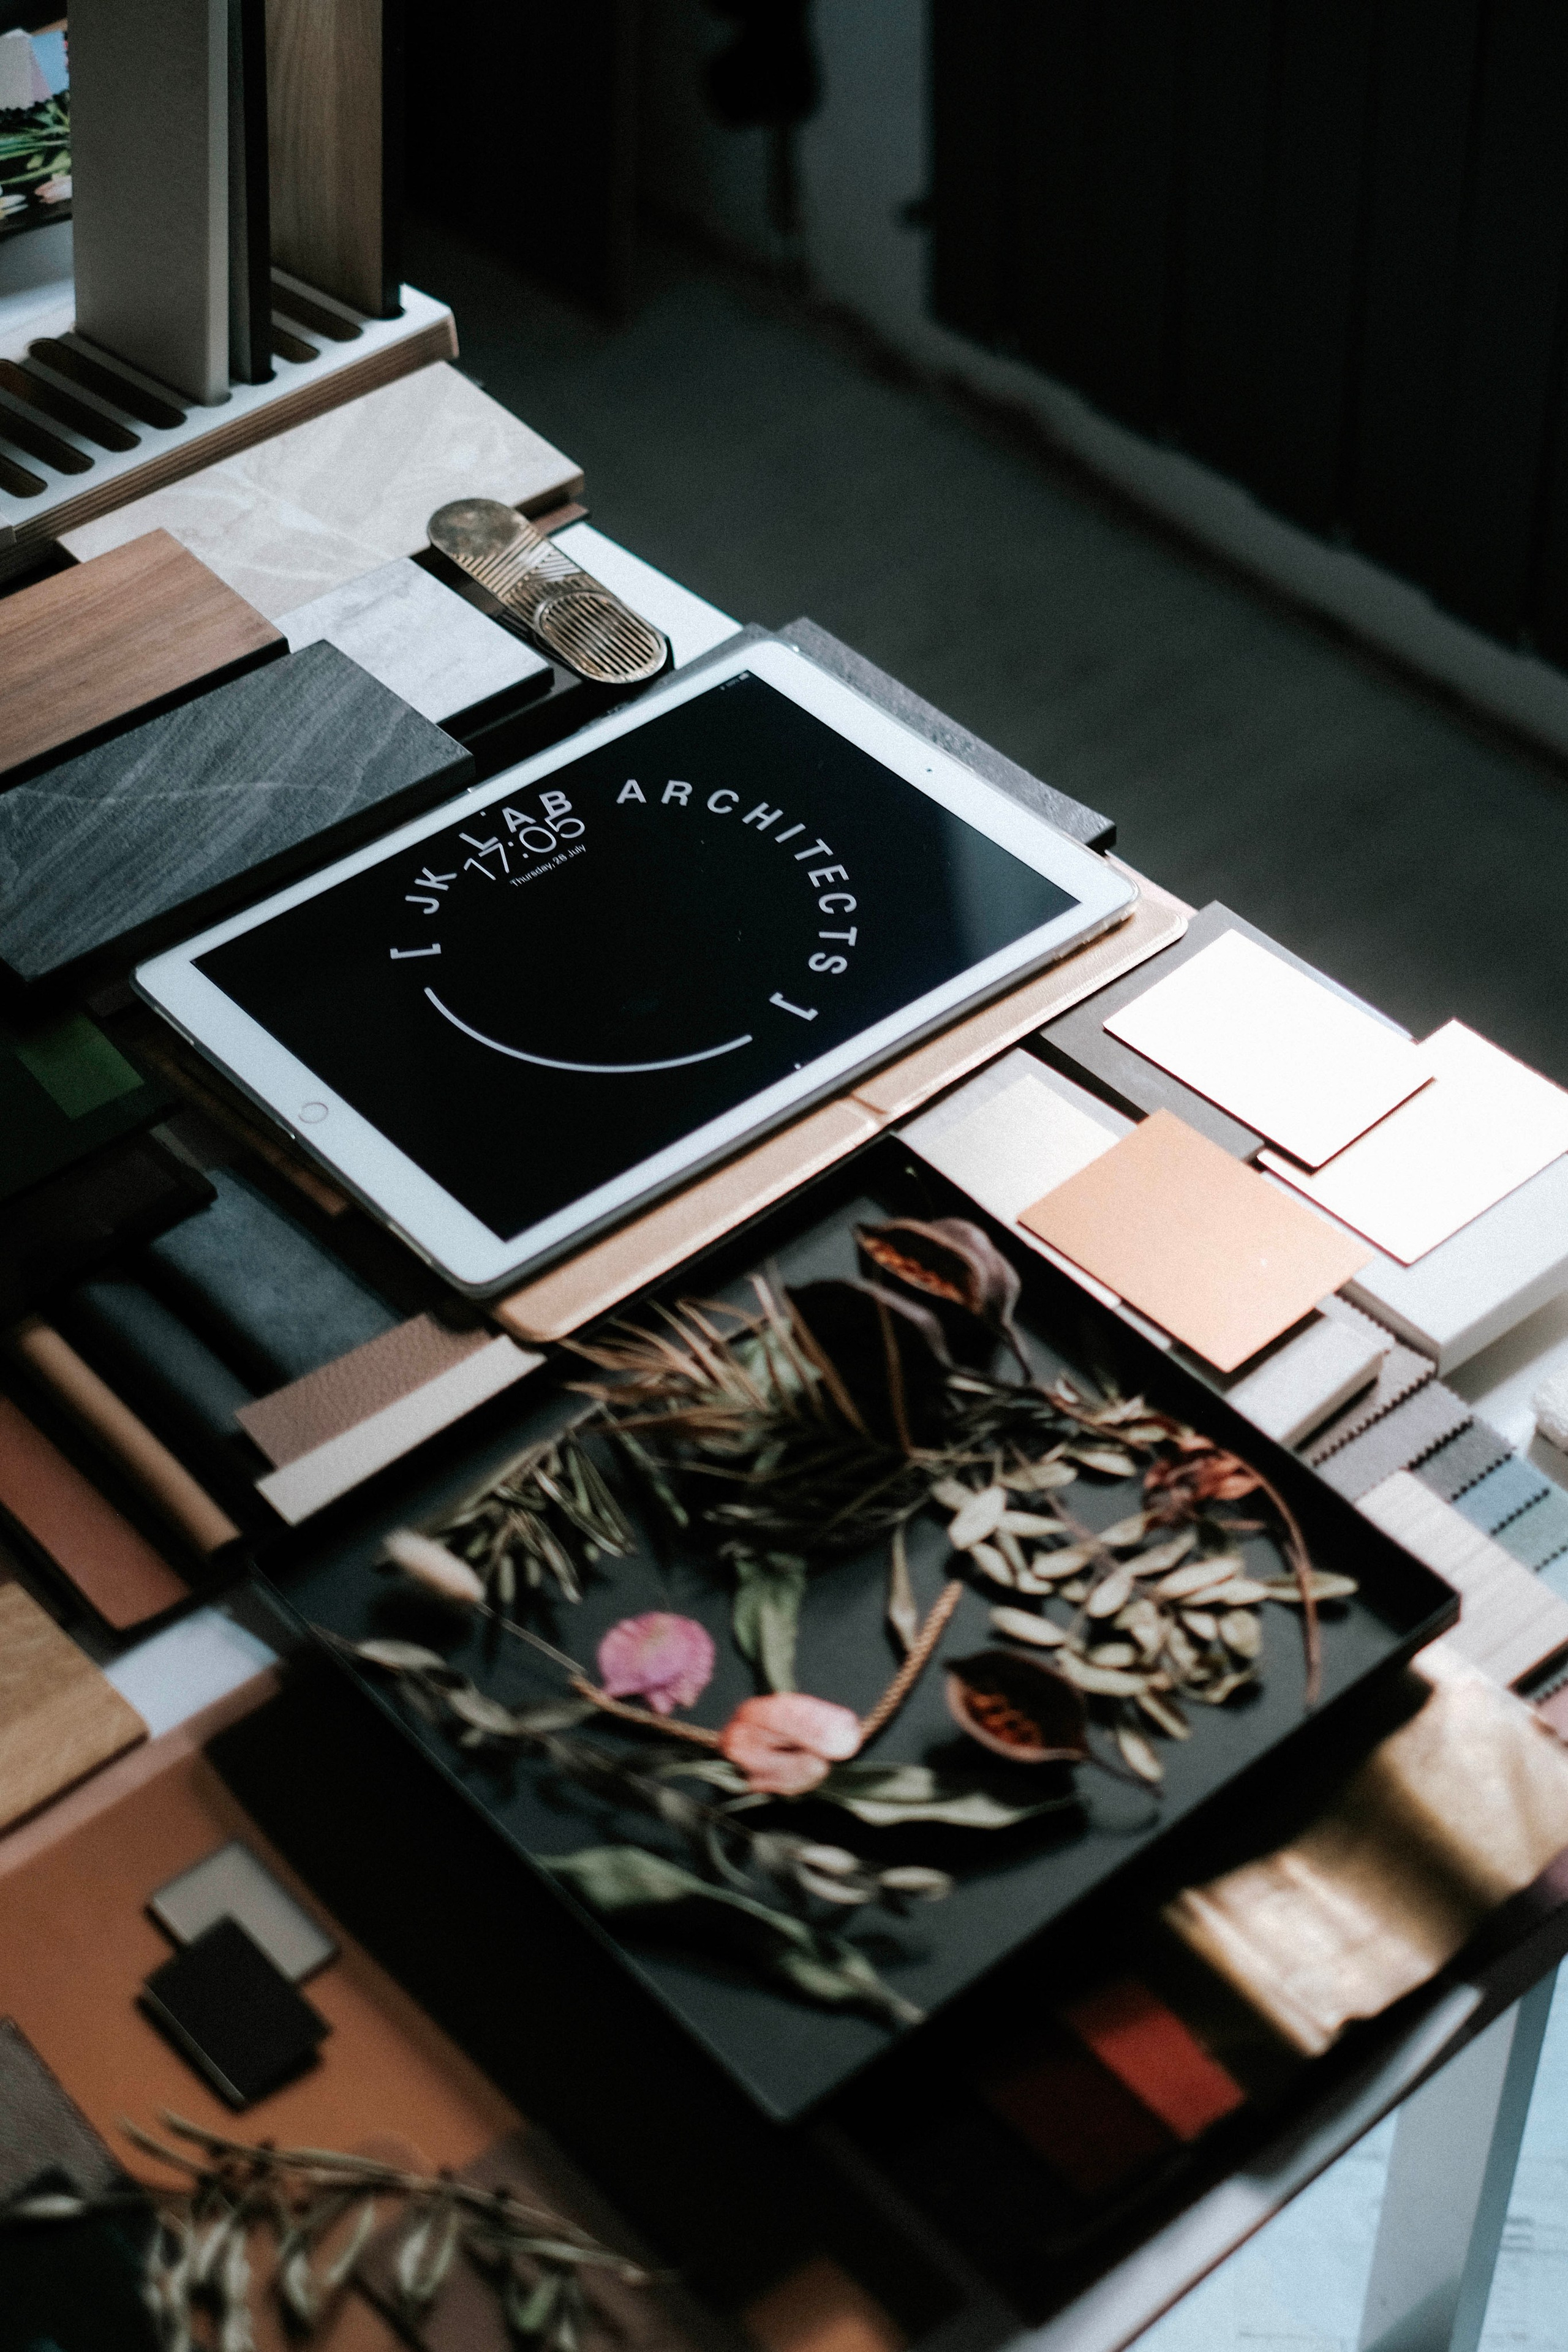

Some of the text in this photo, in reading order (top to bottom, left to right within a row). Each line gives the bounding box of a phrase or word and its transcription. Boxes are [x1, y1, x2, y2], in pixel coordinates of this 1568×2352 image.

[405, 867, 458, 914] JK
[459, 790, 573, 850] LAB
[616, 779, 858, 974] ARCHITECTS
[463, 817, 585, 881] 17:05
[509, 862, 556, 887] Thursday,
[568, 844, 587, 858] July
